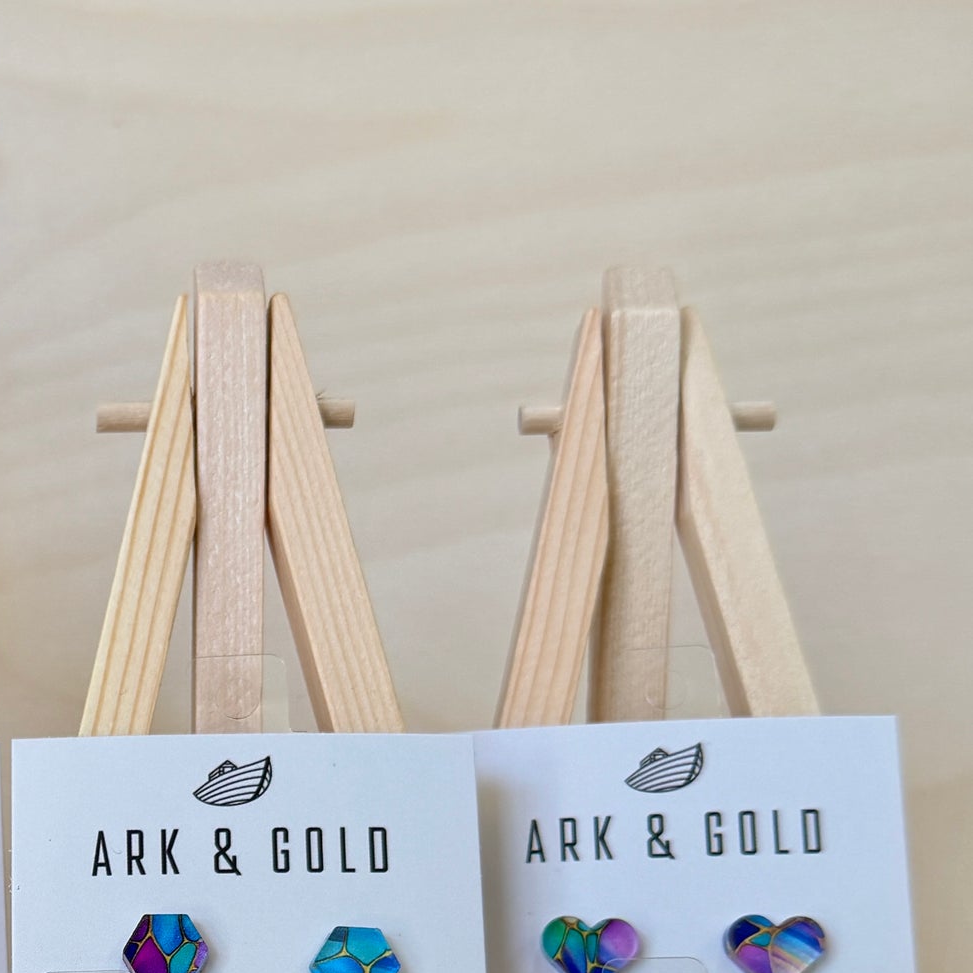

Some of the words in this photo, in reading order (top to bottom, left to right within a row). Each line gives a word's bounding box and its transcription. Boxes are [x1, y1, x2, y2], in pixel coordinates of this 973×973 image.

[92, 829, 179, 876] ARK
[214, 828, 241, 875] &
[272, 827, 388, 873] GOLD
[526, 816, 613, 864] ARK
[647, 814, 675, 859] &
[705, 809, 822, 856] GOLD
